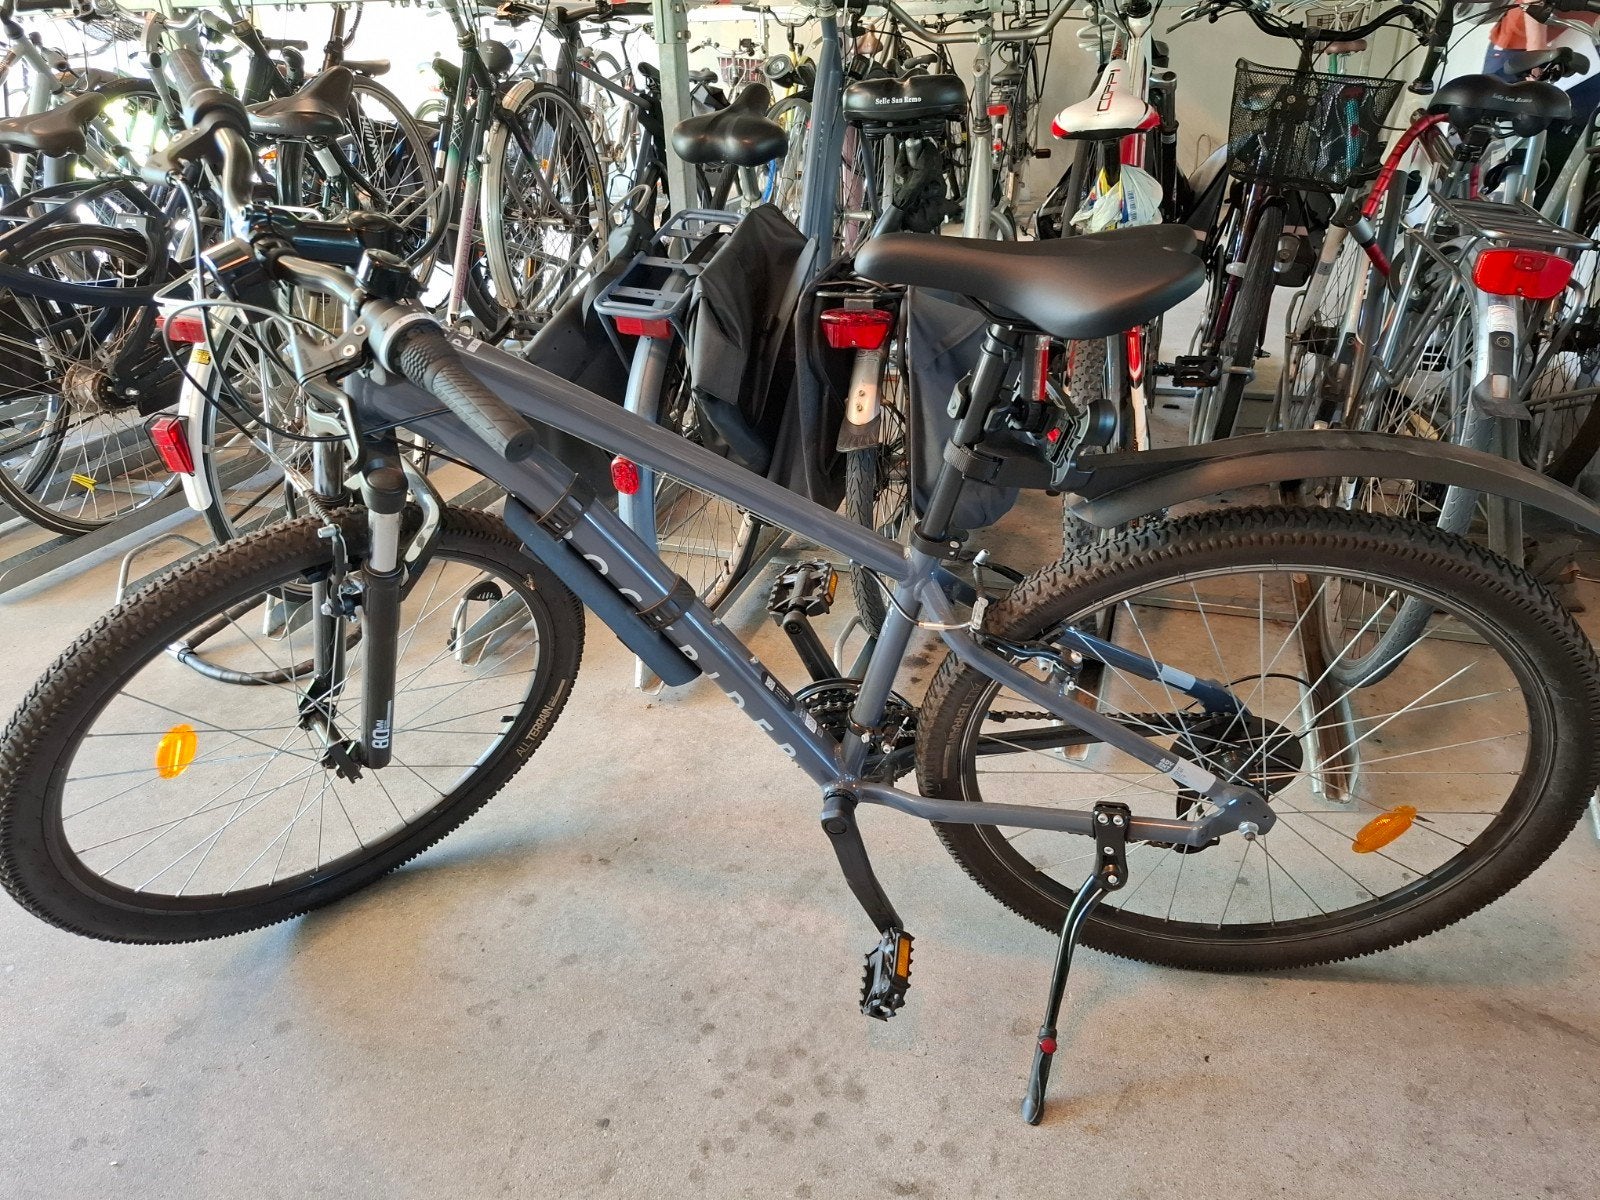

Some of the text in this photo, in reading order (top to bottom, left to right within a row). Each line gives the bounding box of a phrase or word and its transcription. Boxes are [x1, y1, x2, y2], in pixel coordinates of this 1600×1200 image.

[875, 97, 890, 105] Selle
[1096, 68, 1121, 112] COPPI
[516, 704, 554, 758] ALL TERRAIN
